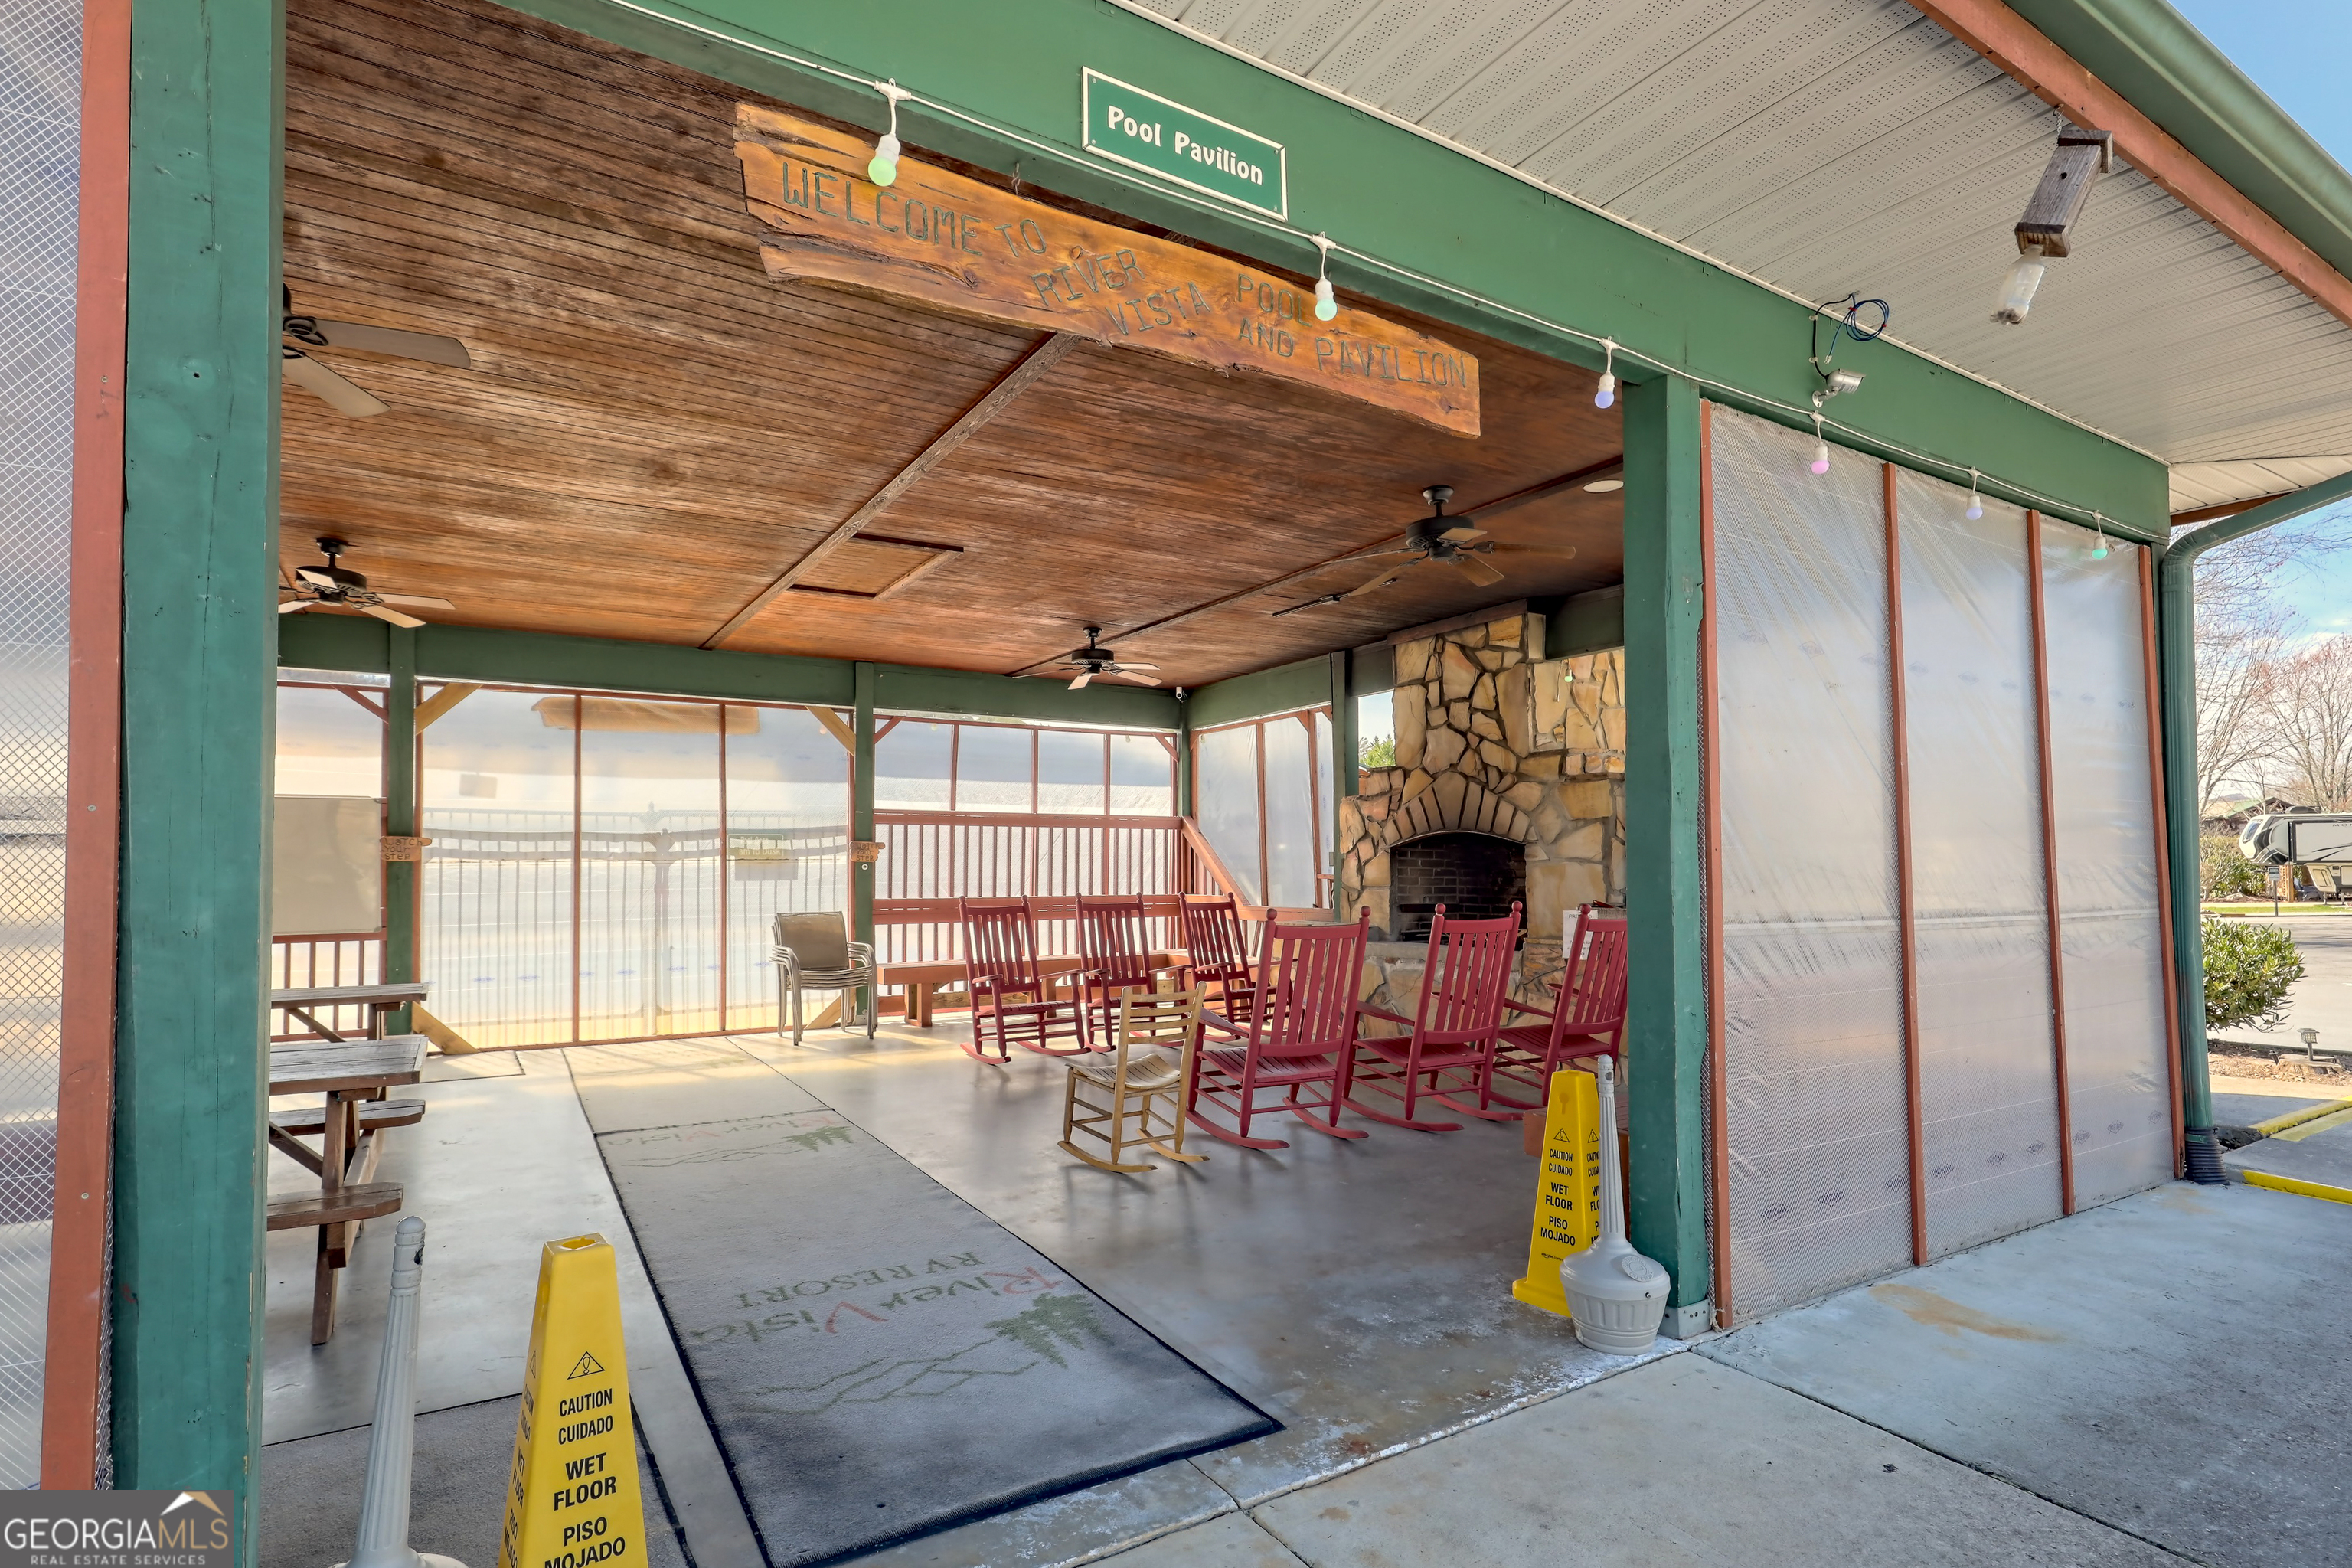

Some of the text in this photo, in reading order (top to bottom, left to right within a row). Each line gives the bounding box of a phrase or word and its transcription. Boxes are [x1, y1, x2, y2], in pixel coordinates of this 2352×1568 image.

[1107, 105, 1264, 186] Pool Pavilion
[782, 162, 1048, 258] WELCOME TO
[1031, 248, 1145, 306] RIVER
[1105, 281, 1212, 336] VISTA
[1238, 273, 1312, 327] POOL
[1237, 318, 1467, 388] AND PAVILION
[1549, 1163, 1573, 1176] CUIDADO
[1550, 1148, 1573, 1161] CAUTION
[1545, 1195, 1573, 1211] FLOOR
[1550, 1182, 1570, 1196] WET
[1540, 1227, 1576, 1246] MOJADO
[1549, 1216, 1568, 1230] PISO
[736, 1251, 985, 1309] RV RESORT
[877, 1266, 1063, 1311] River
[559, 1388, 613, 1417] CAUTION
[558, 1415, 613, 1445] CUIDADO
[565, 1452, 607, 1481] WET
[554, 1476, 617, 1511] FLOOR
[564, 1517, 608, 1547] PISO
[544, 1537, 626, 1568] MOJADO
